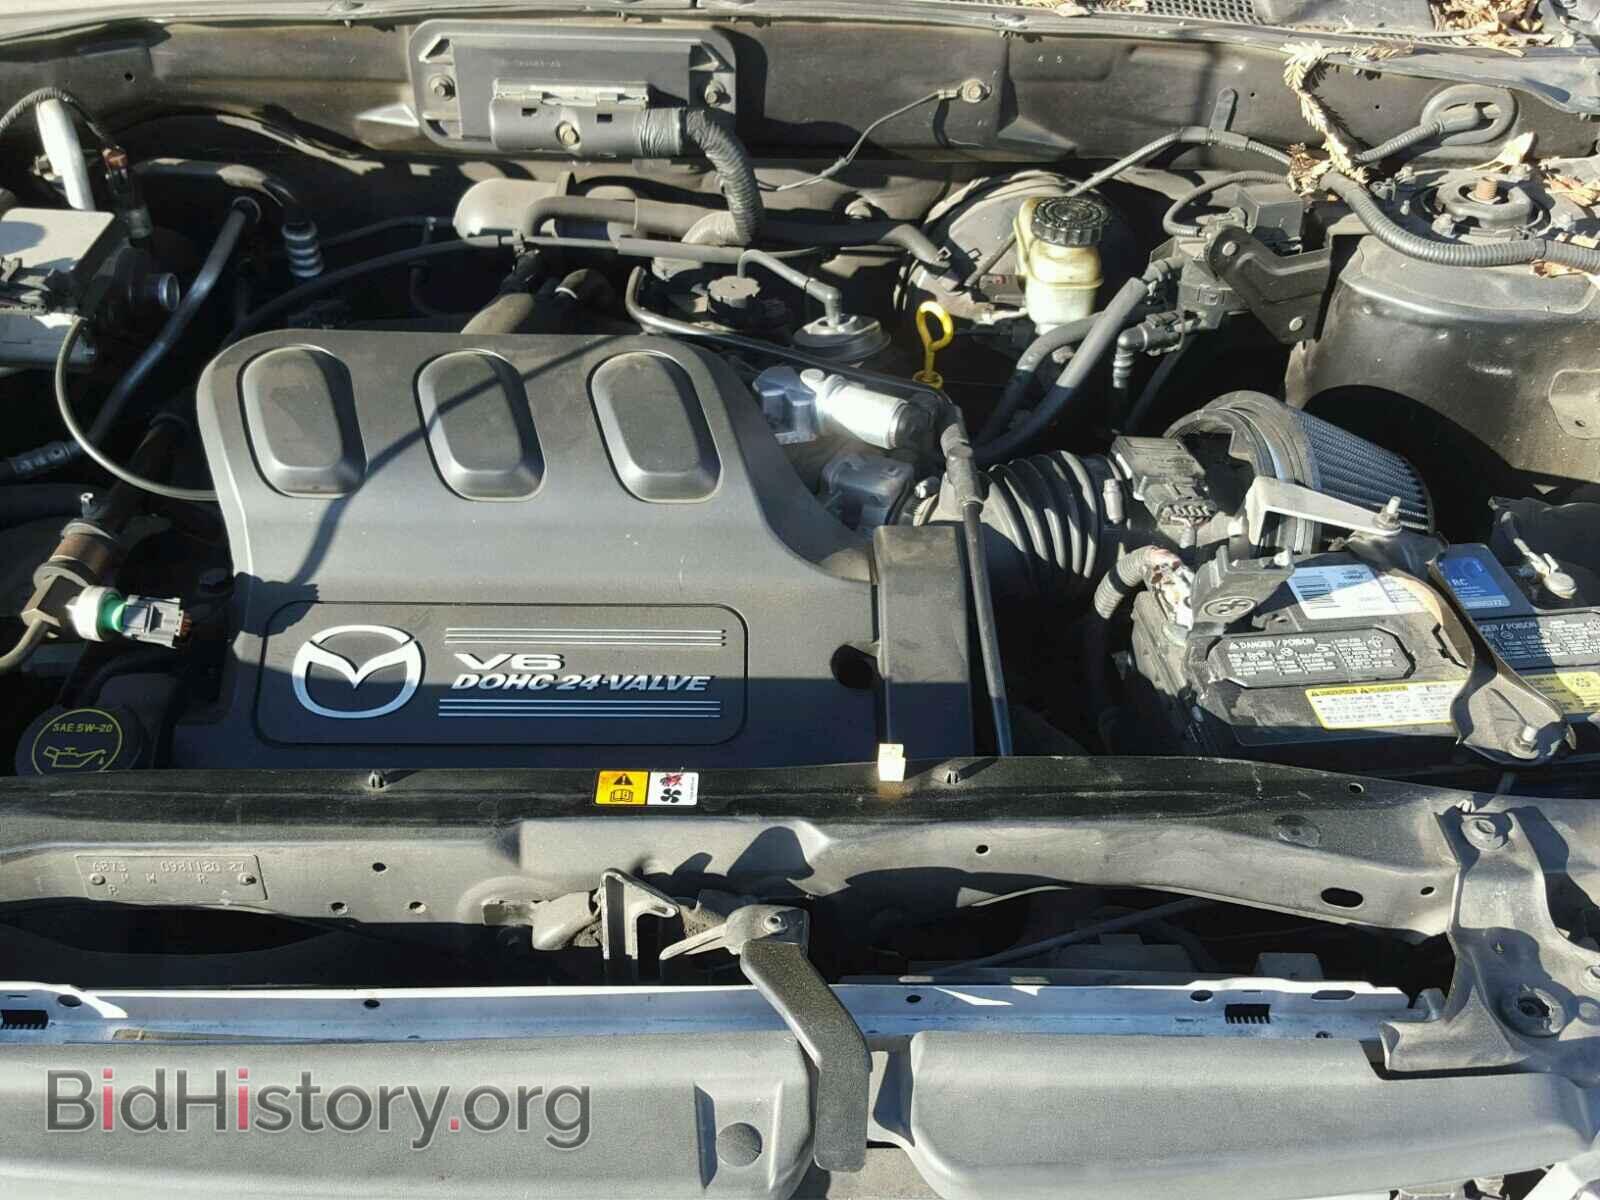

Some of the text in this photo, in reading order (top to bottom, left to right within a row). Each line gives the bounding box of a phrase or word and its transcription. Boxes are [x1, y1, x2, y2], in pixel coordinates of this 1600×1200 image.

[1239, 640, 1276, 649] DANGER
[1282, 638, 1316, 647] POISON
[453, 653, 564, 671] V6
[451, 673, 711, 692] DOHC 24-VALVE
[52, 722, 114, 733] SAE 5W-20
